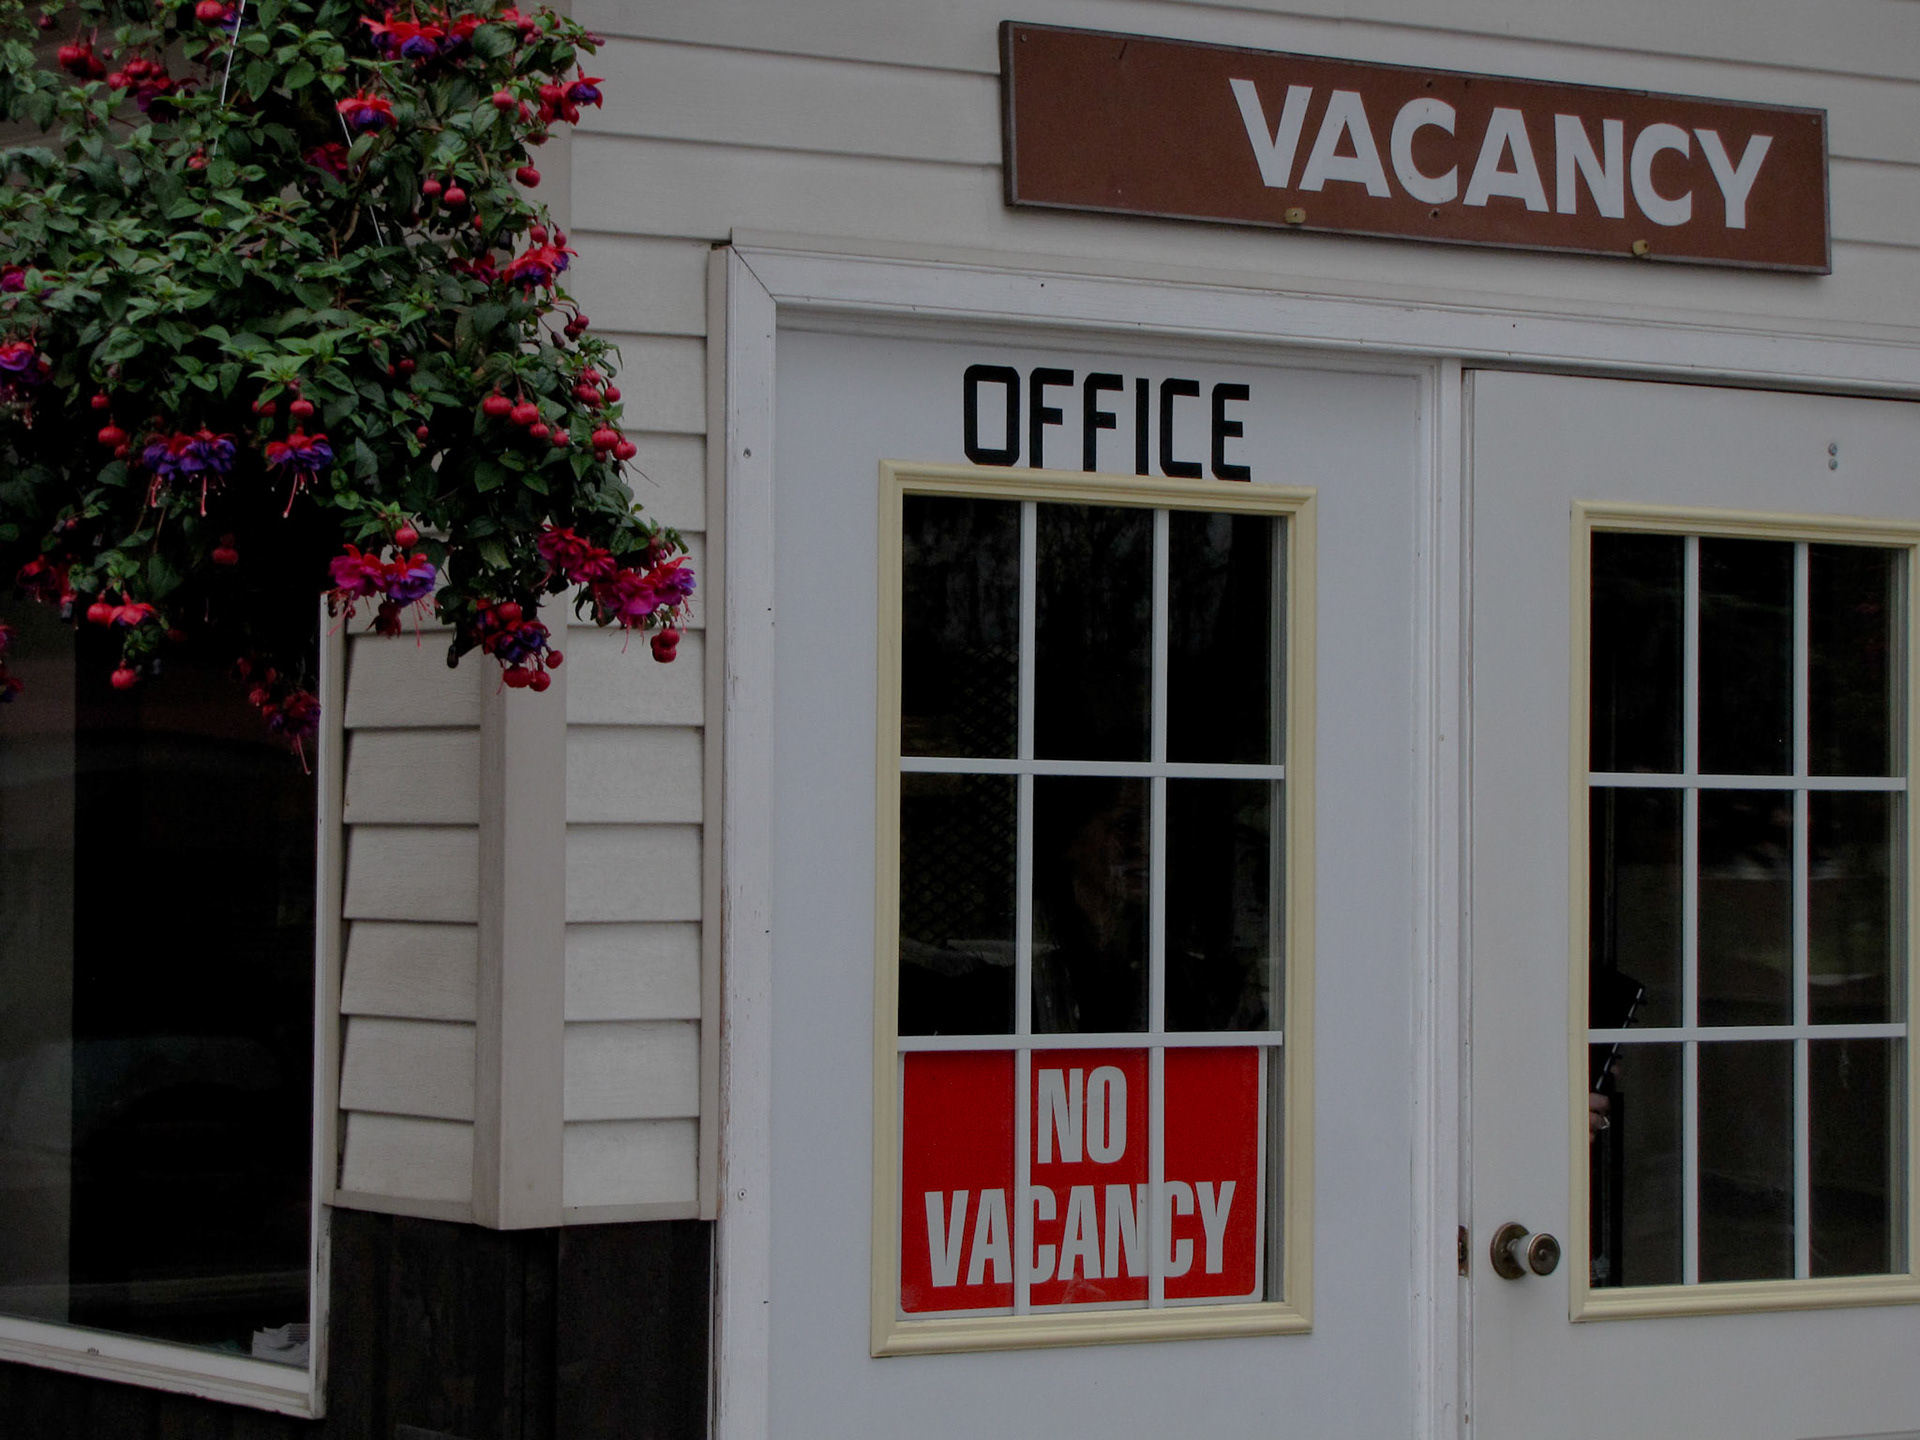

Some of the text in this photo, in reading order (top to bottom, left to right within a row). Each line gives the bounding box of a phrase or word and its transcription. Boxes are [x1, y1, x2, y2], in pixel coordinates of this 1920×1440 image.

[1228, 77, 1773, 230] VACANCY
[963, 364, 1251, 482] OFFICE
[1037, 1065, 1127, 1164] NO
[924, 1180, 1237, 1288] VACANCY
